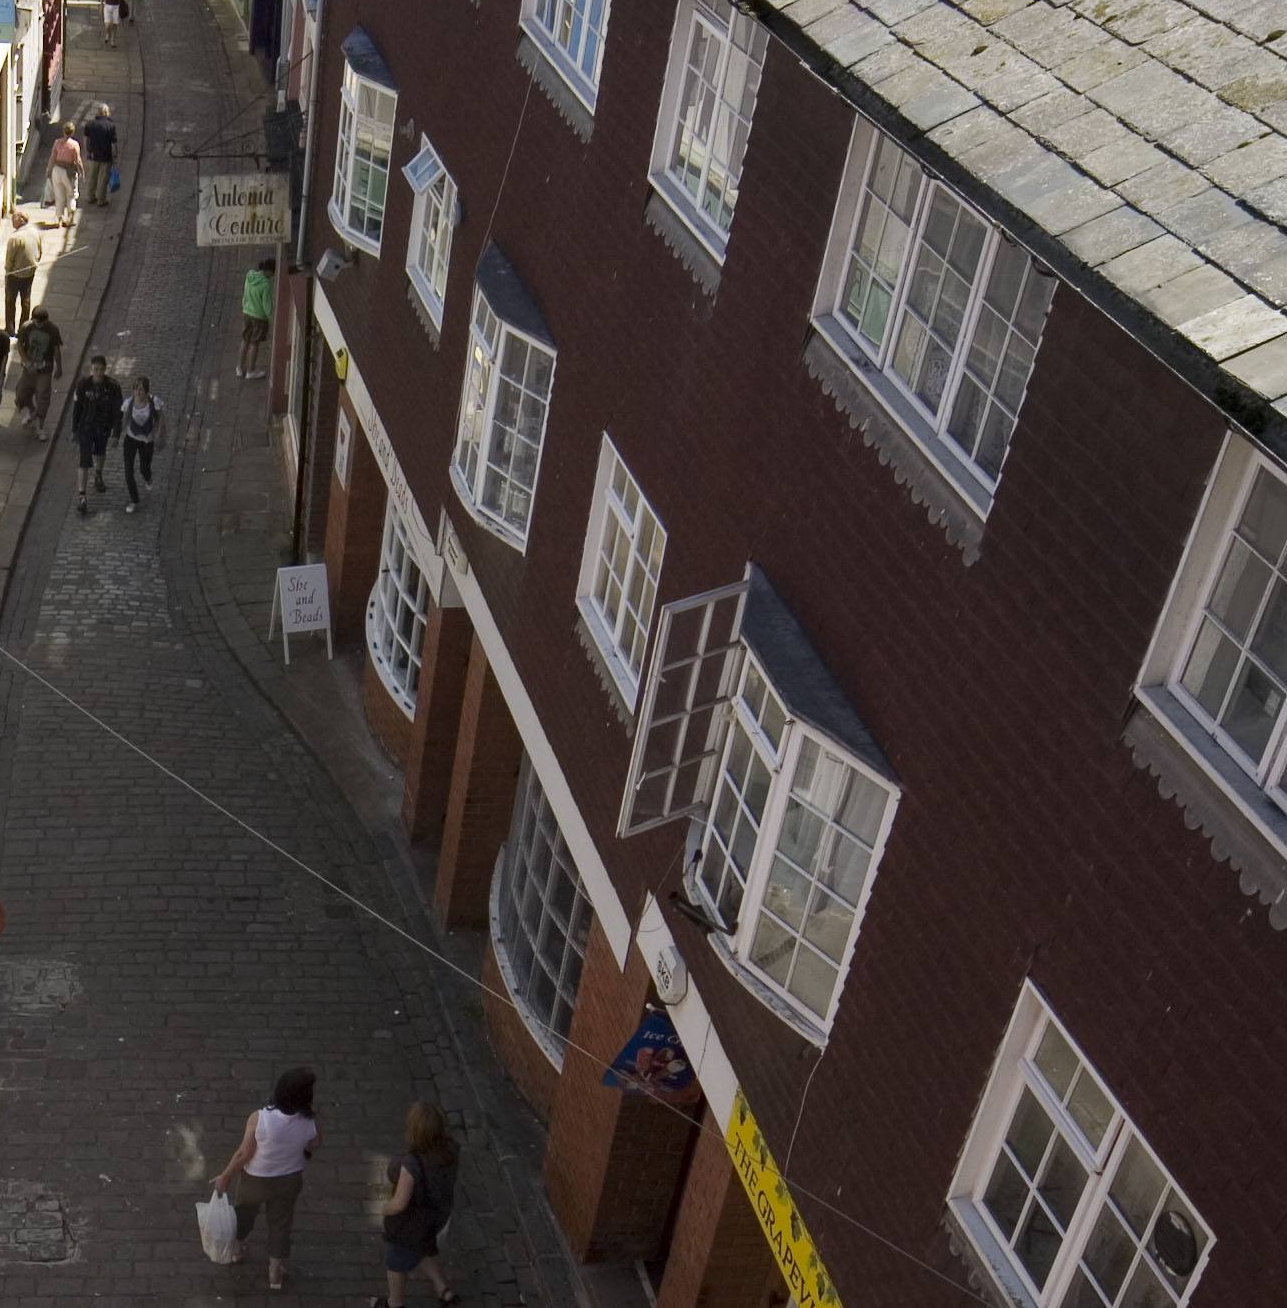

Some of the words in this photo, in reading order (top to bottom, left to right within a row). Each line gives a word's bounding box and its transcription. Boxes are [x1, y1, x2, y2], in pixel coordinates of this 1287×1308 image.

[201, 183, 275, 209] Antonia
[209, 212, 283, 236] Couture
[287, 574, 308, 592] She
[295, 588, 317, 605] and
[289, 605, 323, 624] Beads
[734, 1132, 760, 1198] THE
